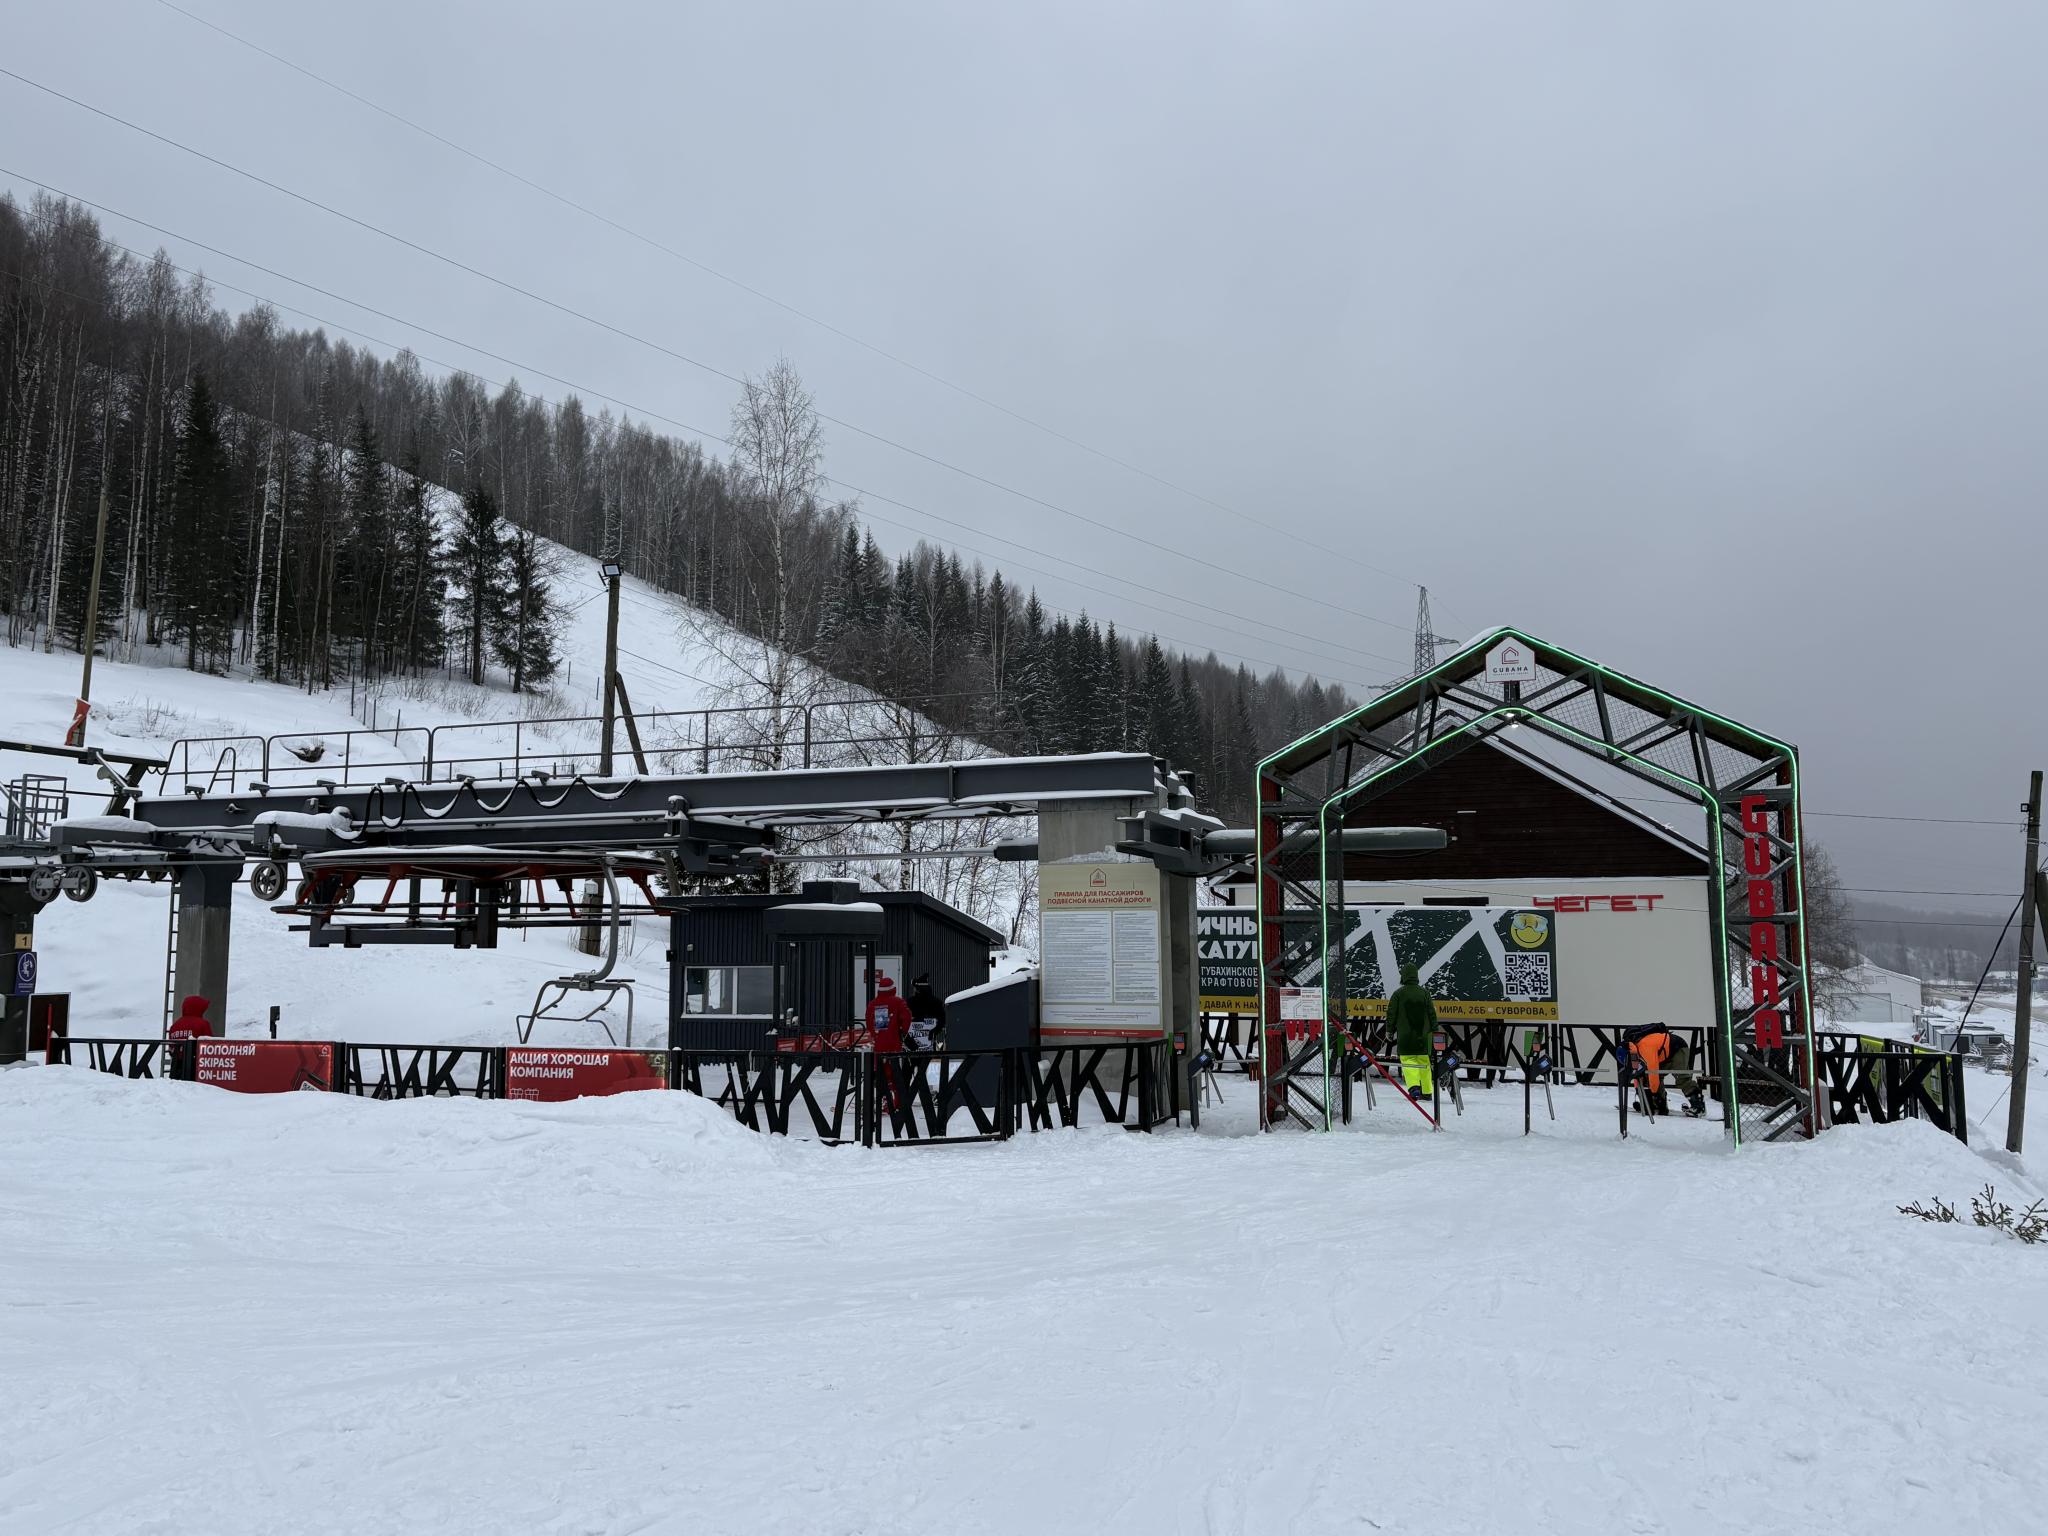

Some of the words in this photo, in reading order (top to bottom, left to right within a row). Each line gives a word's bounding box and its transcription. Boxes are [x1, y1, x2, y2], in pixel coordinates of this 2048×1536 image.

[1533, 895, 1664, 912] ЧЕГЕТ
[22, 936, 28, 946] 1
[1201, 966, 1258, 977] ГУБАХИНСКОЕ
[1201, 978, 1258, 988] КРАФТОВОЕ
[1204, 1000, 1233, 1010] ДАВАЙ
[1439, 1006, 1466, 1015] МИРА,
[1496, 1006, 1548, 1016] СУВОРОВА,
[1551, 1006, 1556, 1015] 9
[200, 1043, 256, 1056] ПОПОЛНЯЙ
[199, 1057, 236, 1068] SKIPASS
[510, 1053, 549, 1067] АКЦИЯ
[550, 1054, 609, 1066] ХОРОШАЯ
[198, 1070, 237, 1080] ON-LINE
[510, 1067, 574, 1078] КОМПАНИЯ
